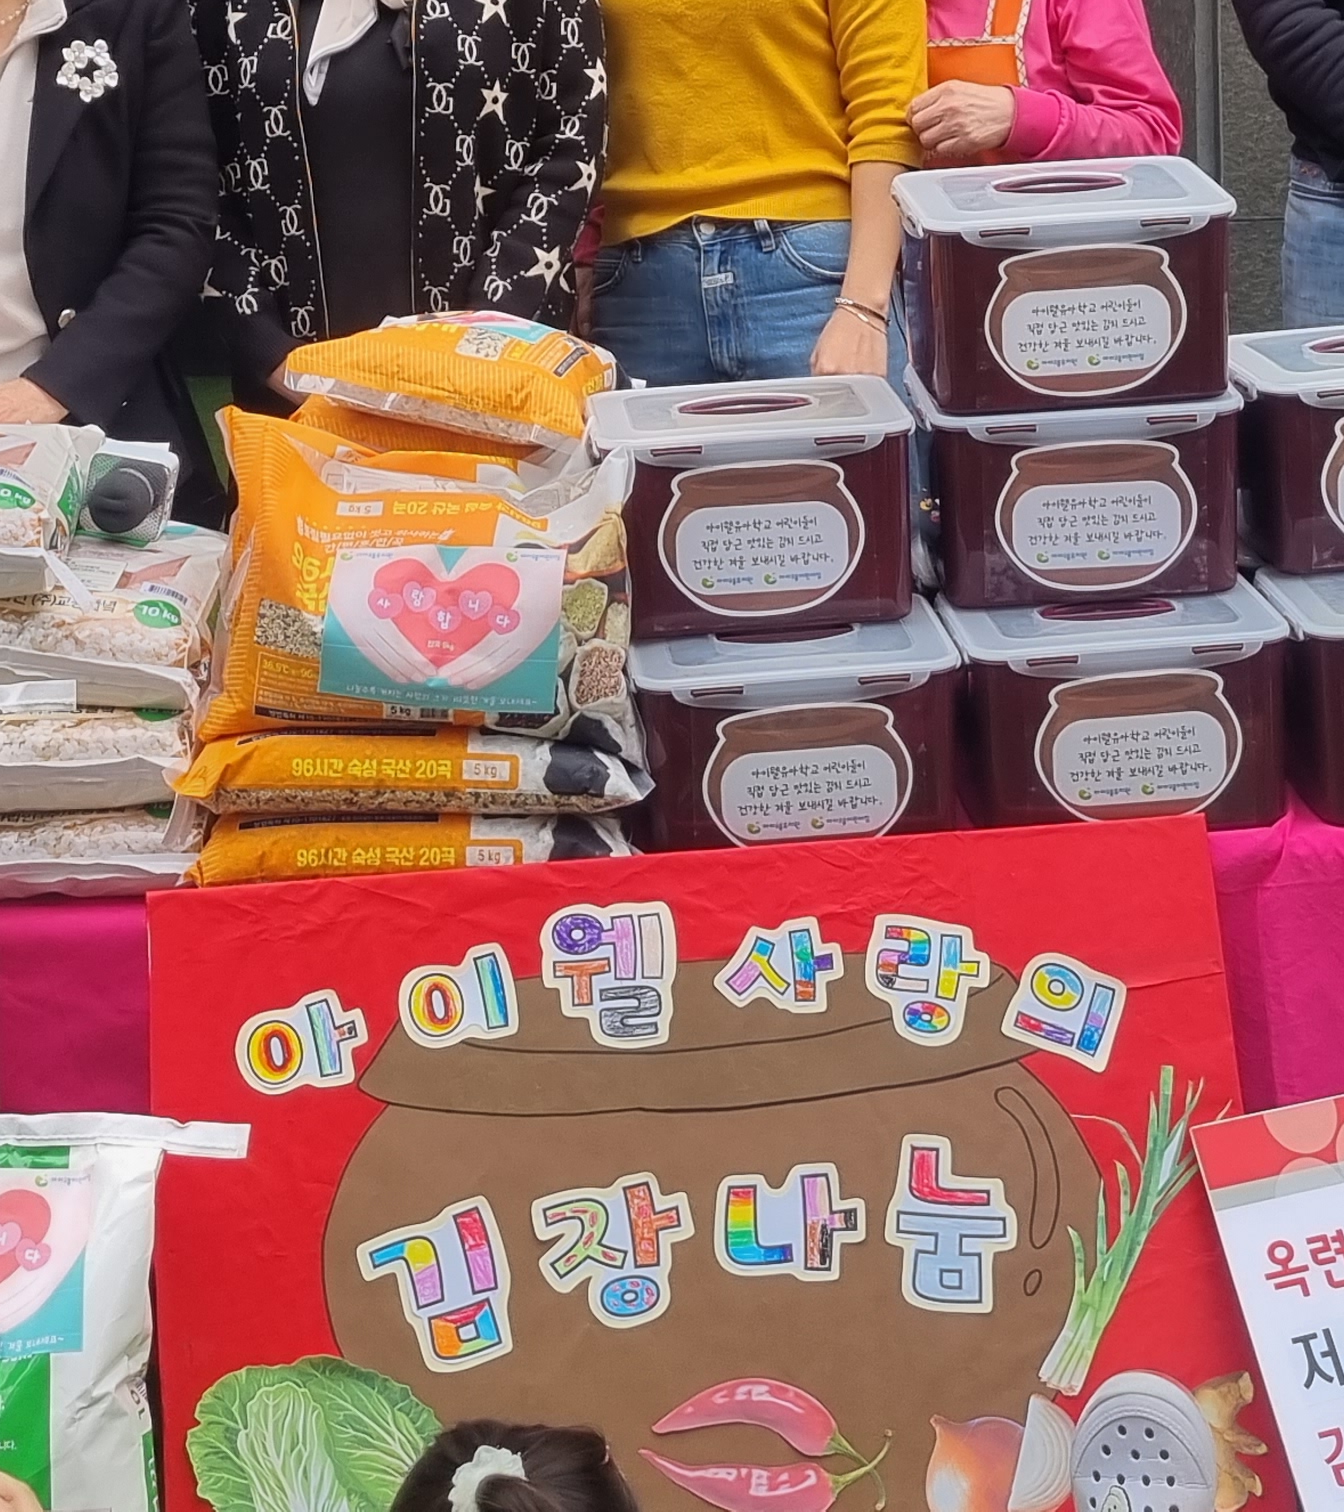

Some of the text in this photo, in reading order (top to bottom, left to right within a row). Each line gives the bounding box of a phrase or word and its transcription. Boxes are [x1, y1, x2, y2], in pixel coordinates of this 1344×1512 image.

[1100, 298, 1141, 309] 어린이들이
[1027, 323, 1044, 335] 직접
[1072, 319, 1098, 331] 맛있는
[1103, 318, 1118, 330] 김치
[1122, 316, 1147, 327] 드시고
[1018, 334, 1157, 352] 건강한 겨울 보내시길 바랍니다.
[14, 491, 31, 505] kg
[1111, 494, 1151, 507] 어린이들이
[776, 516, 817, 529] 어린이들이
[1037, 517, 1054, 528] 직접
[1082, 514, 1108, 526] 맛있는
[1113, 513, 1128, 524] 김치
[1132, 512, 1157, 522] 드시고
[701, 539, 719, 552] 직접
[747, 537, 774, 549] 맛있는
[778, 535, 794, 547] 김치
[798, 534, 823, 545] 드시고
[1028, 529, 1167, 546] 건강한 겨울 보내시길 바랍니다.
[693, 552, 834, 570] 건강한 겨울 보내시길 바랍니다.
[140, 604, 180, 625] 10 kg
[1154, 726, 1195, 739] 어린이들이
[1079, 752, 1095, 764] 직접
[1125, 747, 1152, 760] 맛있는
[1157, 746, 1172, 757] 김치
[1177, 744, 1202, 755] 드시고
[292, 759, 452, 779] 96시간 숙성 국산 20곡
[474, 763, 498, 778] 5 kg
[823, 759, 865, 773] 어린이들이
[1069, 762, 1211, 782] 건강한 겨울 보내시길 바랍니다.
[747, 786, 764, 799] 직접
[794, 782, 821, 794] 맛있는
[826, 780, 842, 792] 김치
[846, 778, 872, 789] 드시고
[738, 796, 882, 816] 건강한 겨울 보내시길 바랍니다.
[296, 847, 456, 867] 96시간 숙성 국산 20곡
[478, 849, 502, 864] 5 kg
[724, 918, 1116, 1060] 사랑의
